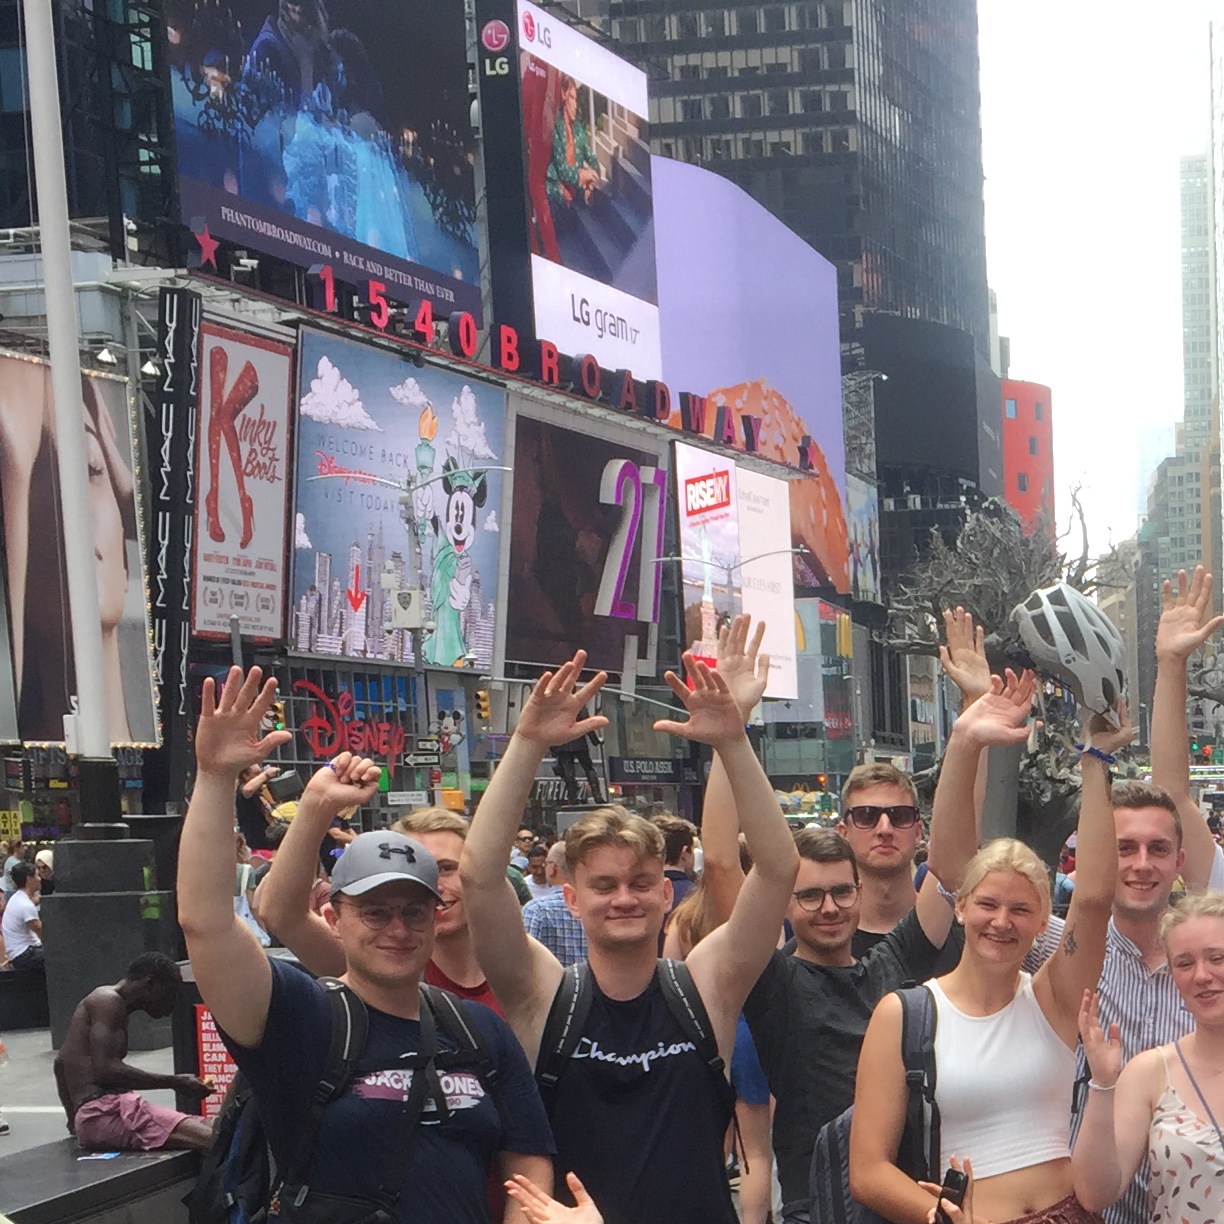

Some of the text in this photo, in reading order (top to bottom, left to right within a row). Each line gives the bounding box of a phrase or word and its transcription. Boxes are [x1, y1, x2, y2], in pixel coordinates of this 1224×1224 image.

[537, 22, 551, 48] LG
[485, 57, 509, 76] LG
[220, 206, 456, 303] PHANTOMBROADWAY.COM BACK AND BETTER THAN EVER
[571, 293, 591, 327] LG
[595, 309, 628, 341] gram
[318, 265, 762, 452] 1540 BROADWAY
[318, 433, 409, 468] WELCOME BACK
[244, 448, 283, 483] Boots
[323, 487, 353, 503] VISIT
[594, 459, 667, 623] 21
[623, 760, 635, 773] U.S.
[636, 761, 654, 773] POLO
[1, 812, 9, 836] ATM
[203, 1053, 226, 1062] CAN
[571, 1037, 696, 1072] Champion
[203, 1064, 222, 1073] THEY
[440, 1076, 485, 1097] ONES
